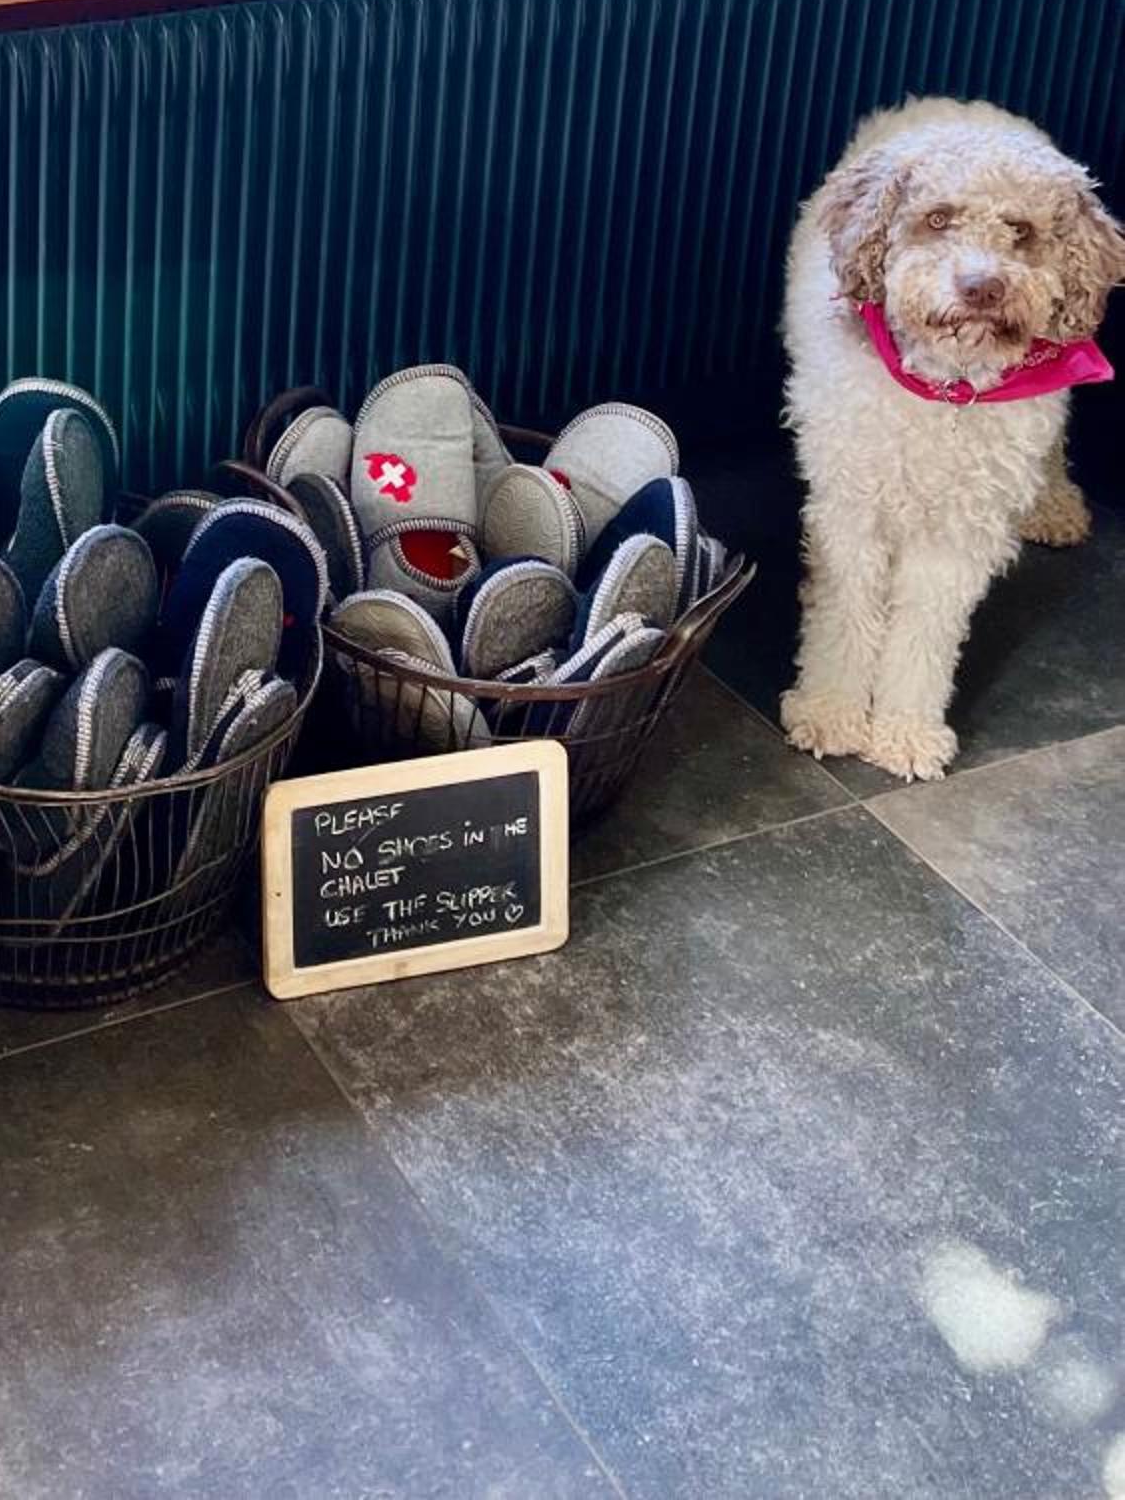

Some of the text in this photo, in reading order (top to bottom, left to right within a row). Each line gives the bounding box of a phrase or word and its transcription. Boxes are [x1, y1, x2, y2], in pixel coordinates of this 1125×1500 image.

[322, 846, 364, 874] NO
[378, 831, 454, 865] SHOES
[320, 866, 406, 898] CHALET
[326, 904, 366, 927] USE
[453, 908, 496, 929] YOU
